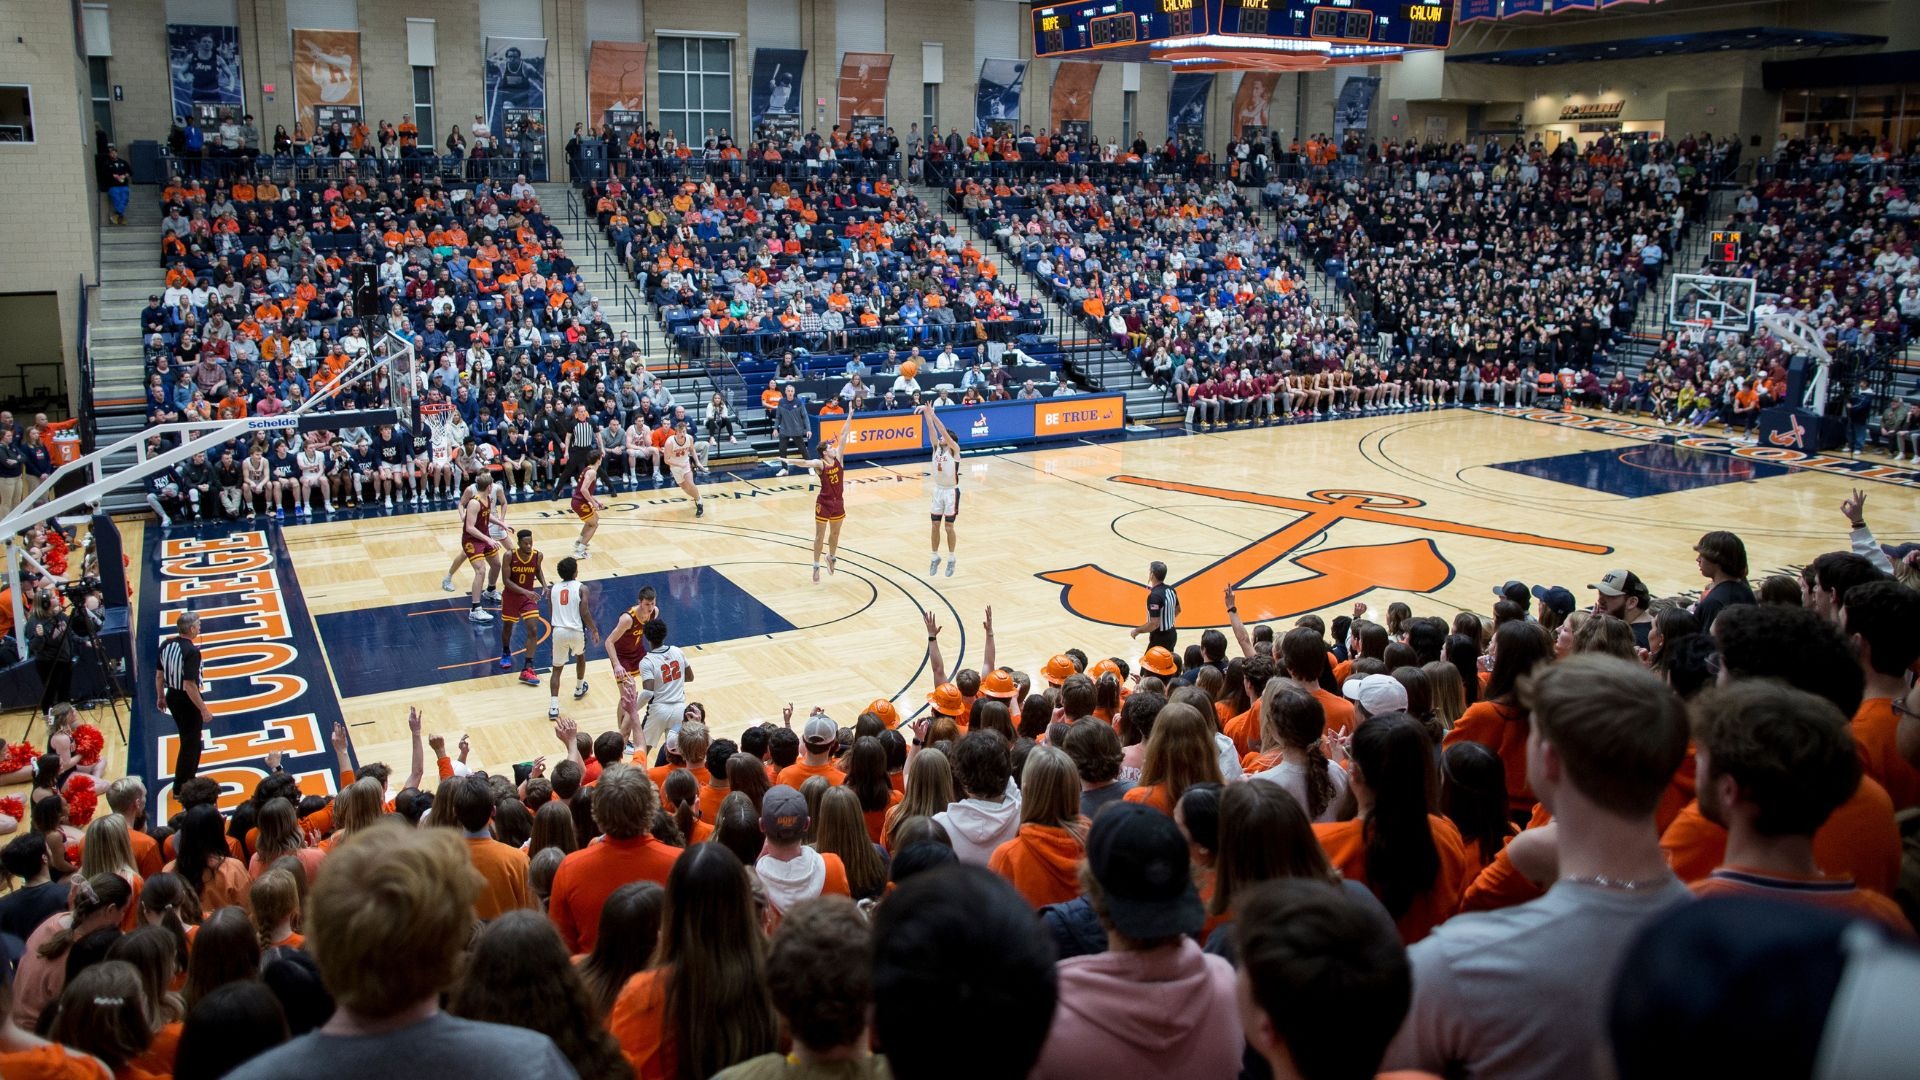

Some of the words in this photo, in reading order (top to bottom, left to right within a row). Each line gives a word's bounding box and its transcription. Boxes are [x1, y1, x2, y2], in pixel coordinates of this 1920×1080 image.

[1411, 5, 1442, 21] CALVIN
[1043, 16, 1060, 32] HOPE
[1724, 243, 1735, 262] 5
[248, 417, 297, 429] Schelde
[1045, 413, 1059, 426] BE
[1063, 409, 1100, 423] TRUE.
[1468, 405, 1692, 442] HOPE
[860, 426, 918, 442] STRONG.
[971, 426, 989, 435] HOPE
[62, 445, 71, 454] G
[829, 473, 839, 484] 23
[519, 574, 526, 584] 0
[559, 589, 569, 606] 0
[159, 530, 309, 717] COLLEGE
[660, 660, 682, 684] 22
